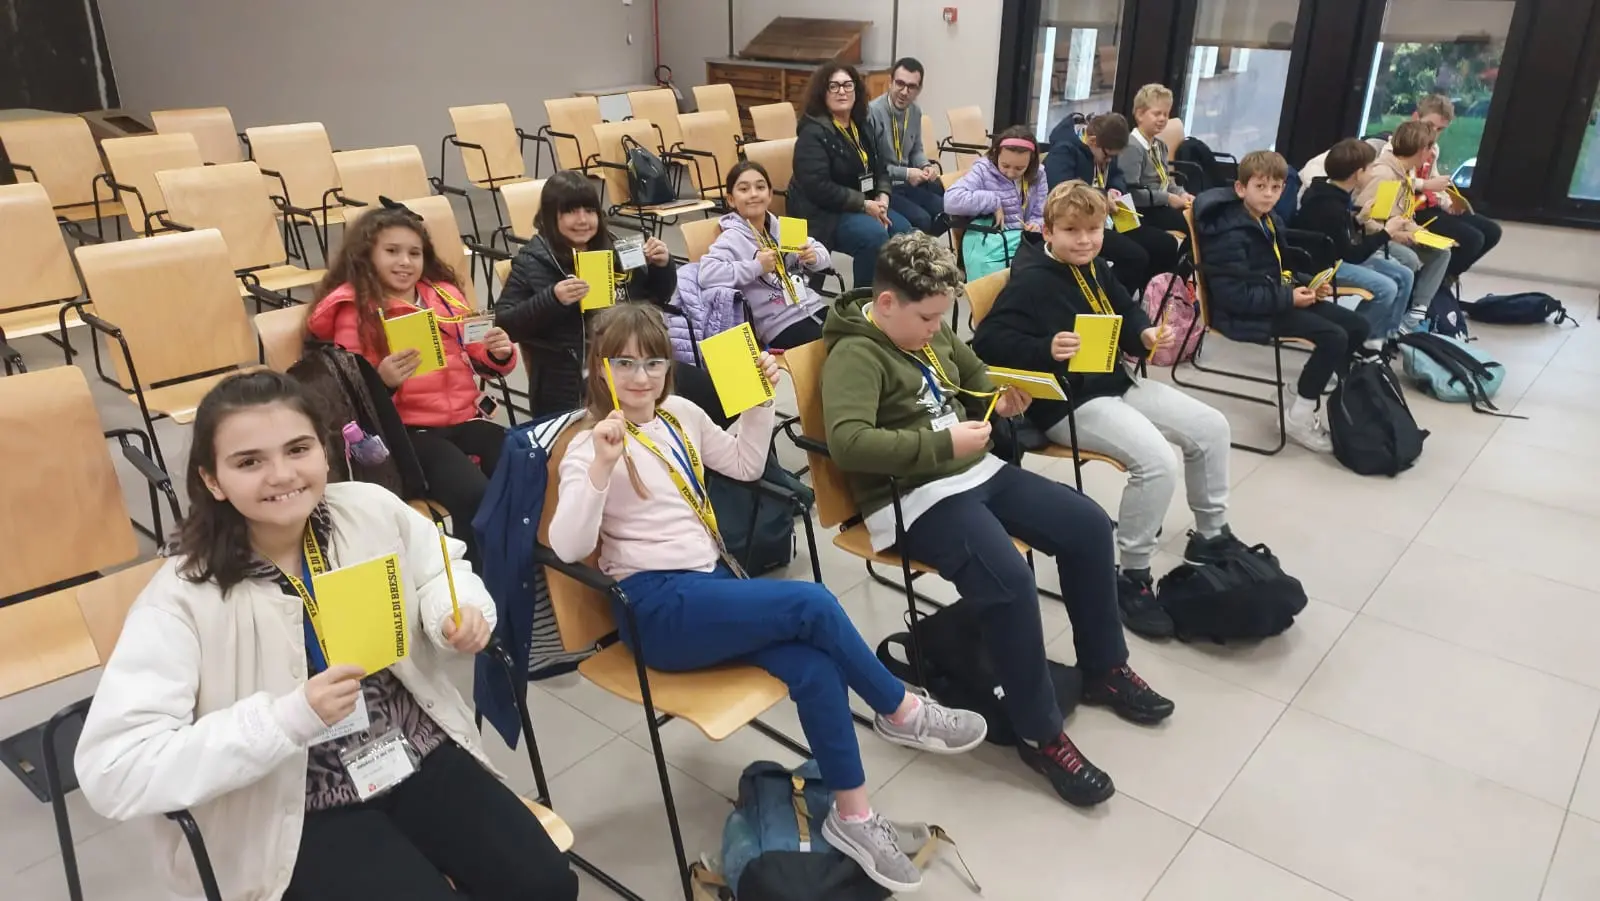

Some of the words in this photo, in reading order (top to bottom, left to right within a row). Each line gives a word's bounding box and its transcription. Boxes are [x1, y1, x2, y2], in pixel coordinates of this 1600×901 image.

[742, 326, 757, 356] BRESCIA
[385, 558, 399, 600] BRESCIA
[296, 583, 318, 617] BRESCIA
[392, 601, 401, 611] DI
[394, 611, 404, 657] GIORNALE
